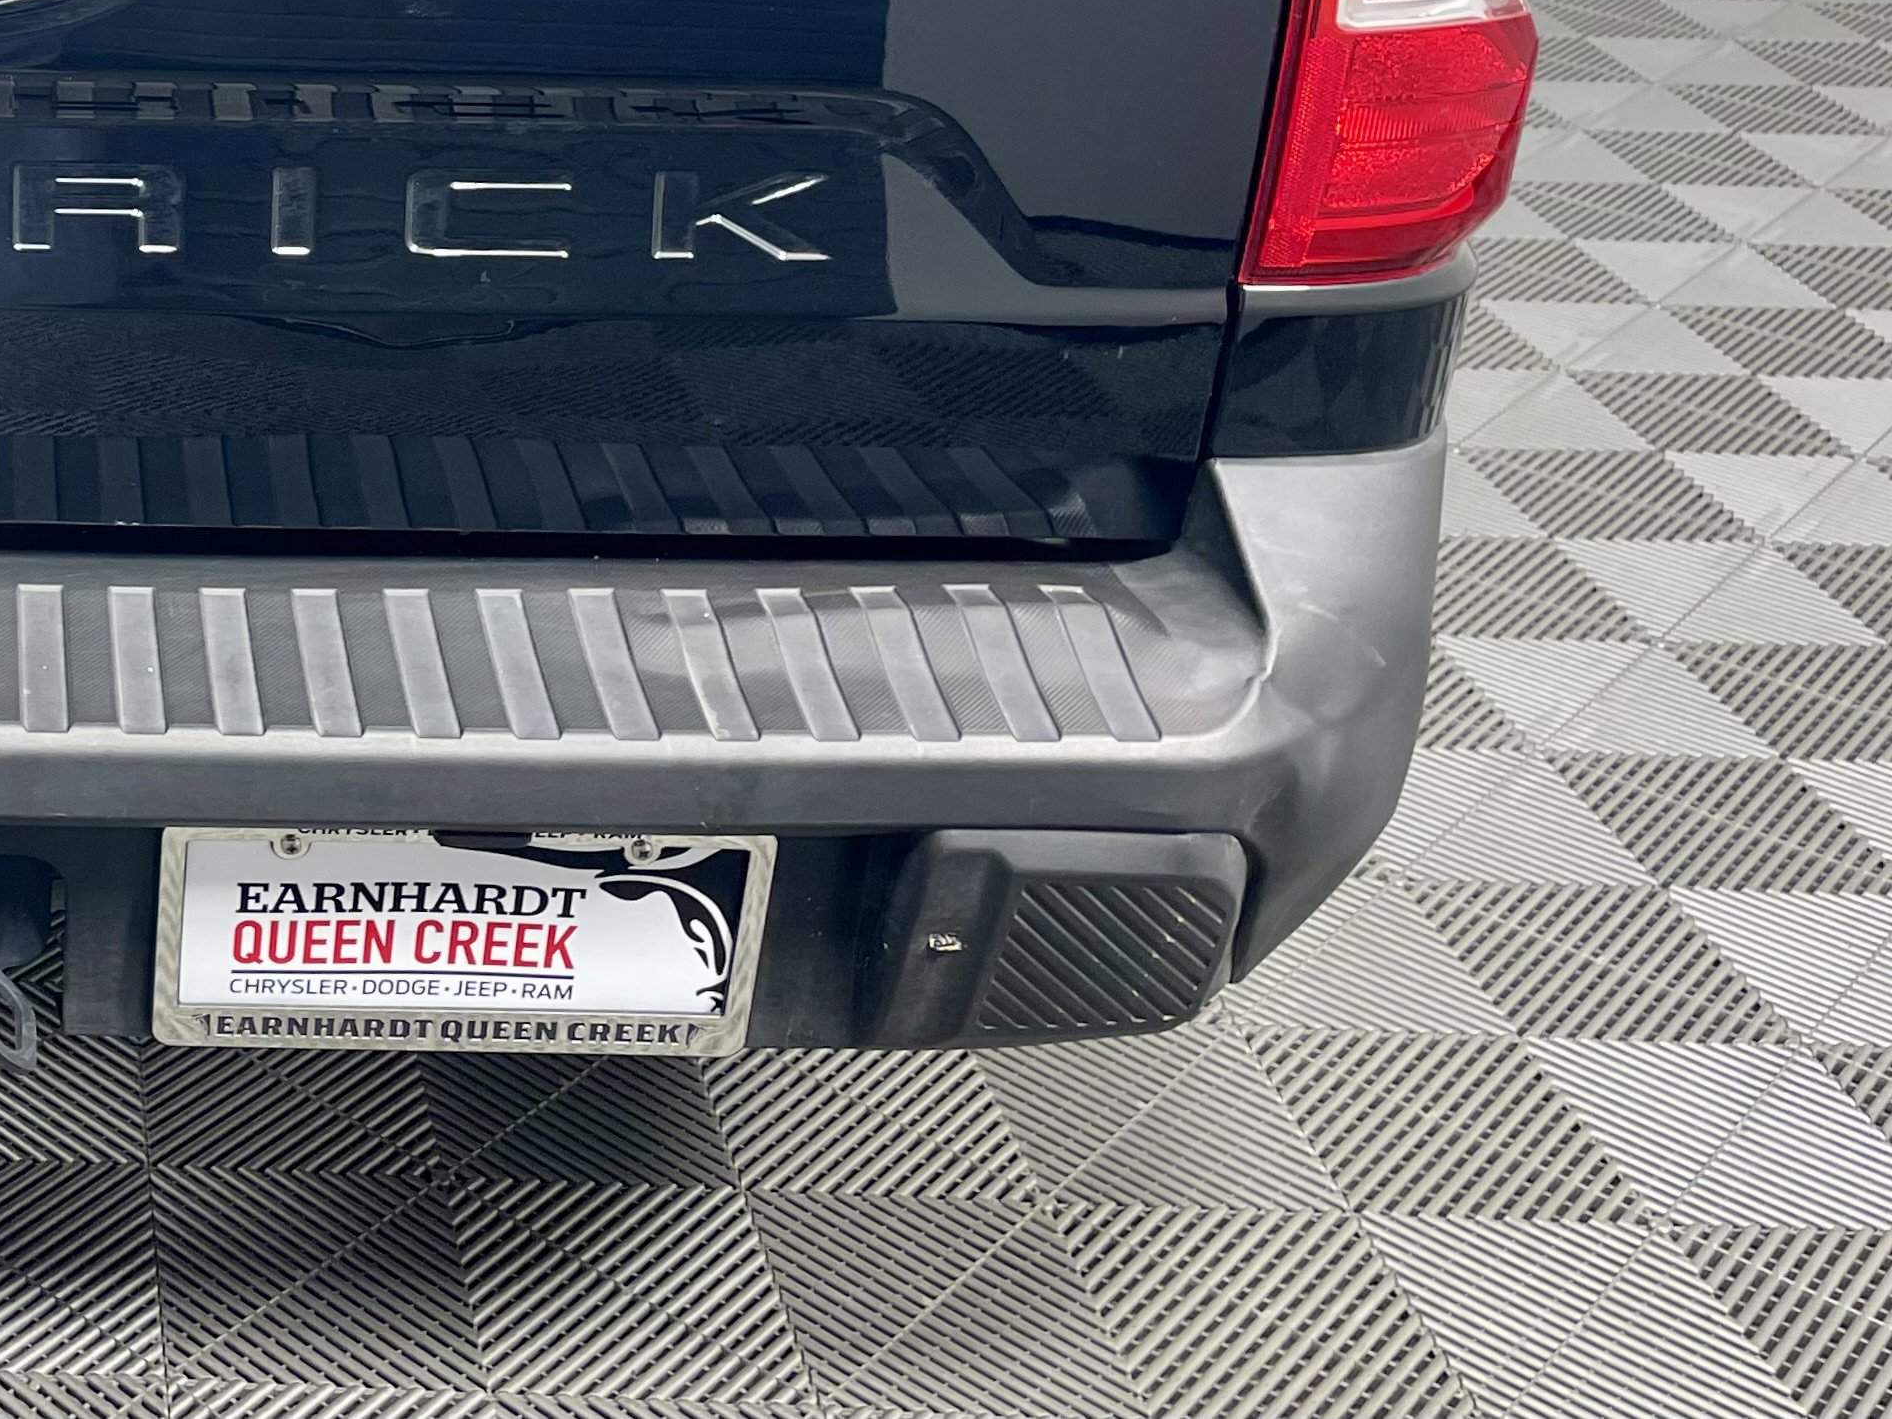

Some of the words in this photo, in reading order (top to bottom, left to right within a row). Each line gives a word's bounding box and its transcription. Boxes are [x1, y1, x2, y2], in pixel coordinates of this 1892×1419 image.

[235, 881, 587, 919] EARNHARDT
[232, 919, 396, 964] QUEEN
[413, 919, 579, 970] CREEK
[229, 978, 347, 995] CHRYSLER
[361, 979, 441, 997] DODGE
[453, 981, 508, 998] JEEP
[521, 984, 574, 1000] RAM
[215, 1014, 434, 1041] EARNHARDT
[440, 1019, 558, 1045] QUEEN
[566, 1022, 682, 1047] CREEK
